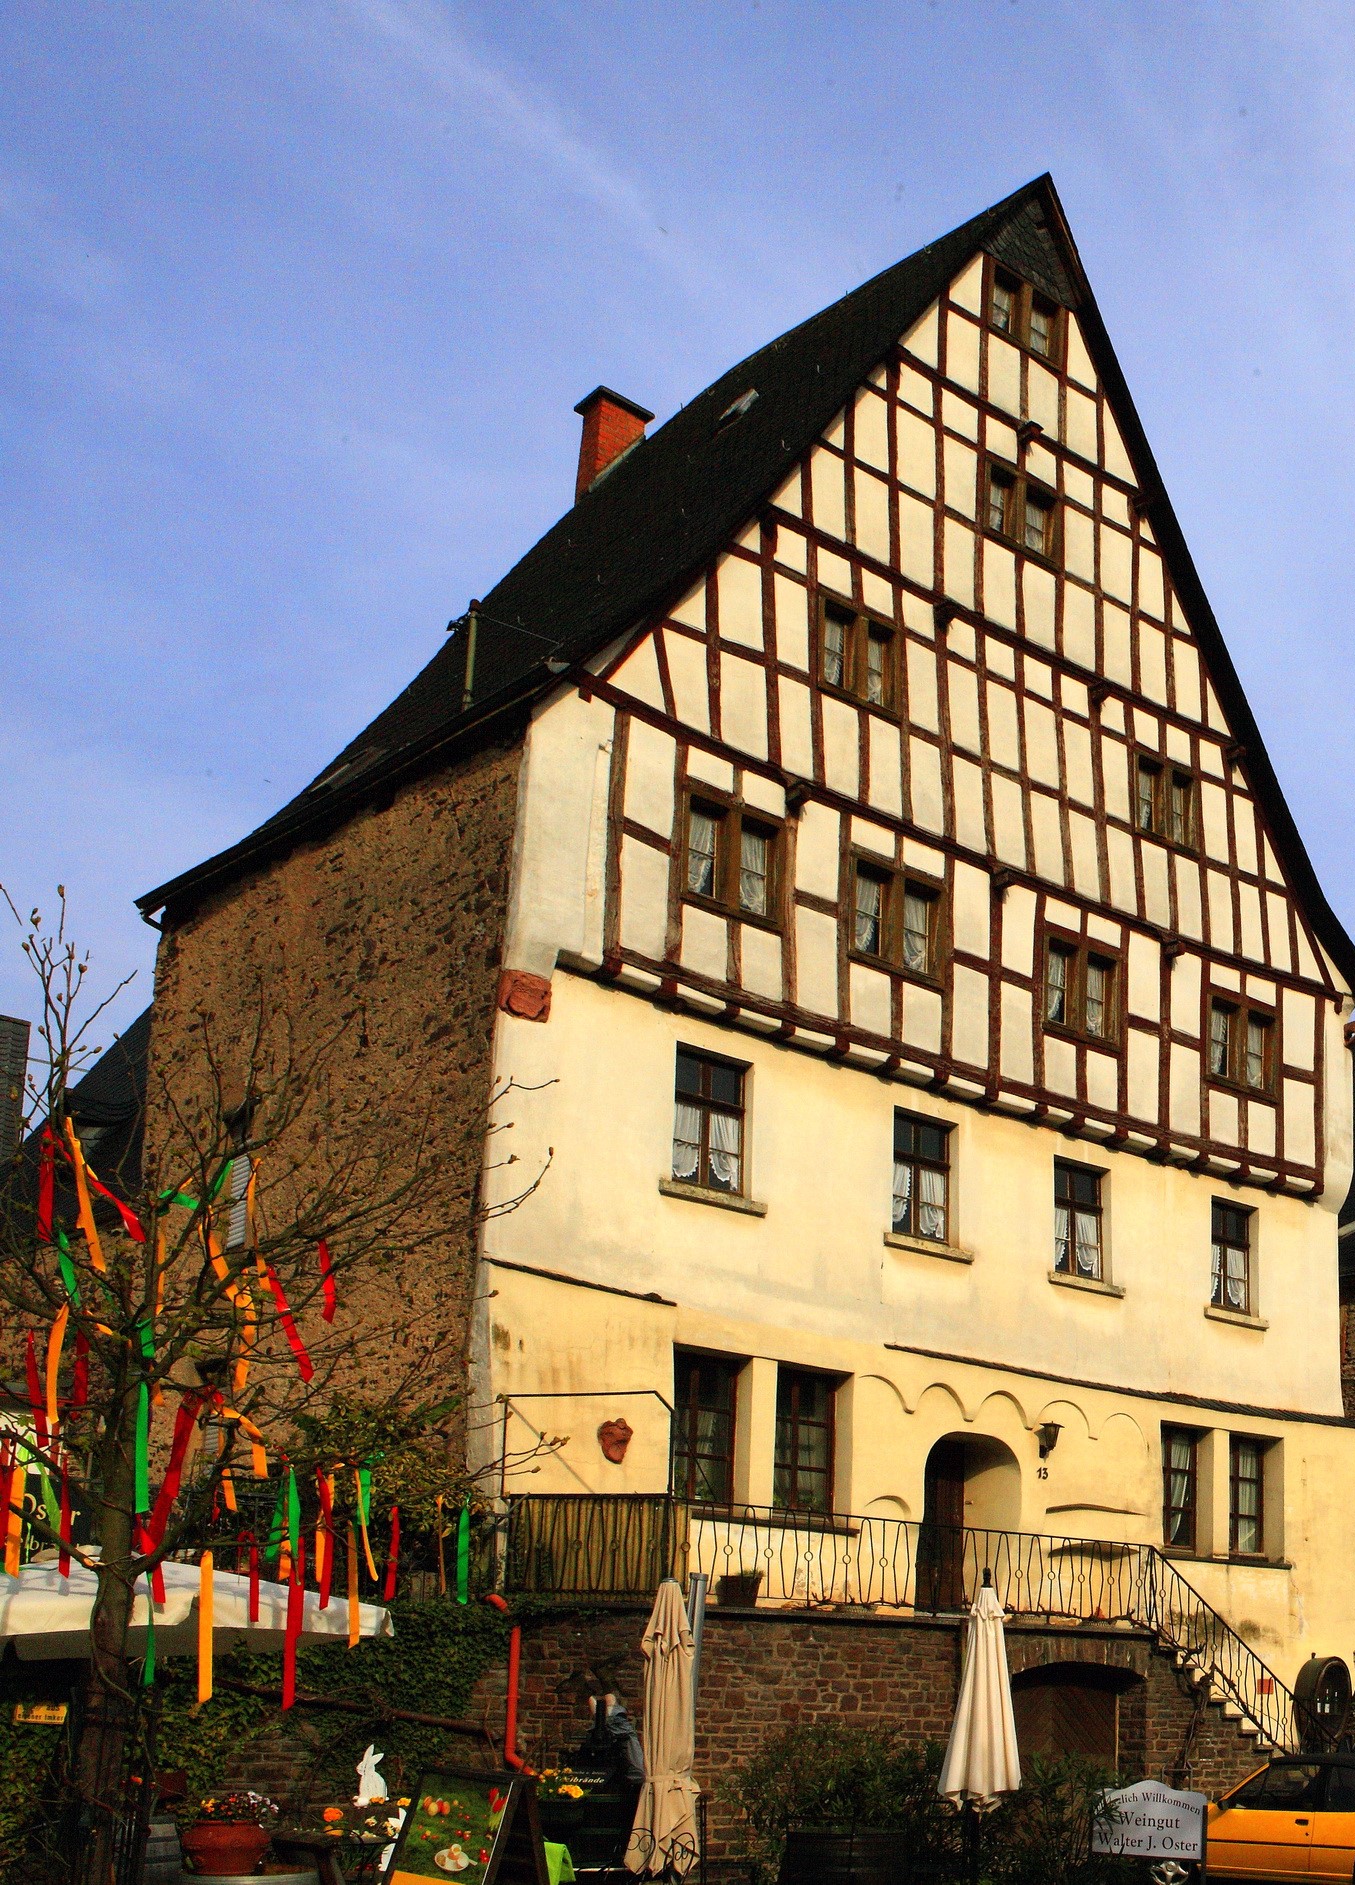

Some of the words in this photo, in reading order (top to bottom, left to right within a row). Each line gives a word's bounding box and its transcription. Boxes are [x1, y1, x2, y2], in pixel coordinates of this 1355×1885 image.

[1036, 1467, 1049, 1480] 13
[20, 1492, 82, 1526] Osr
[1142, 1792, 1202, 1816] Willkommen
[1120, 1811, 1181, 1831] Weingut
[1098, 1832, 1144, 1848] Walter
[1146, 1835, 1157, 1852] J.
[1161, 1836, 1199, 1852] Oster
